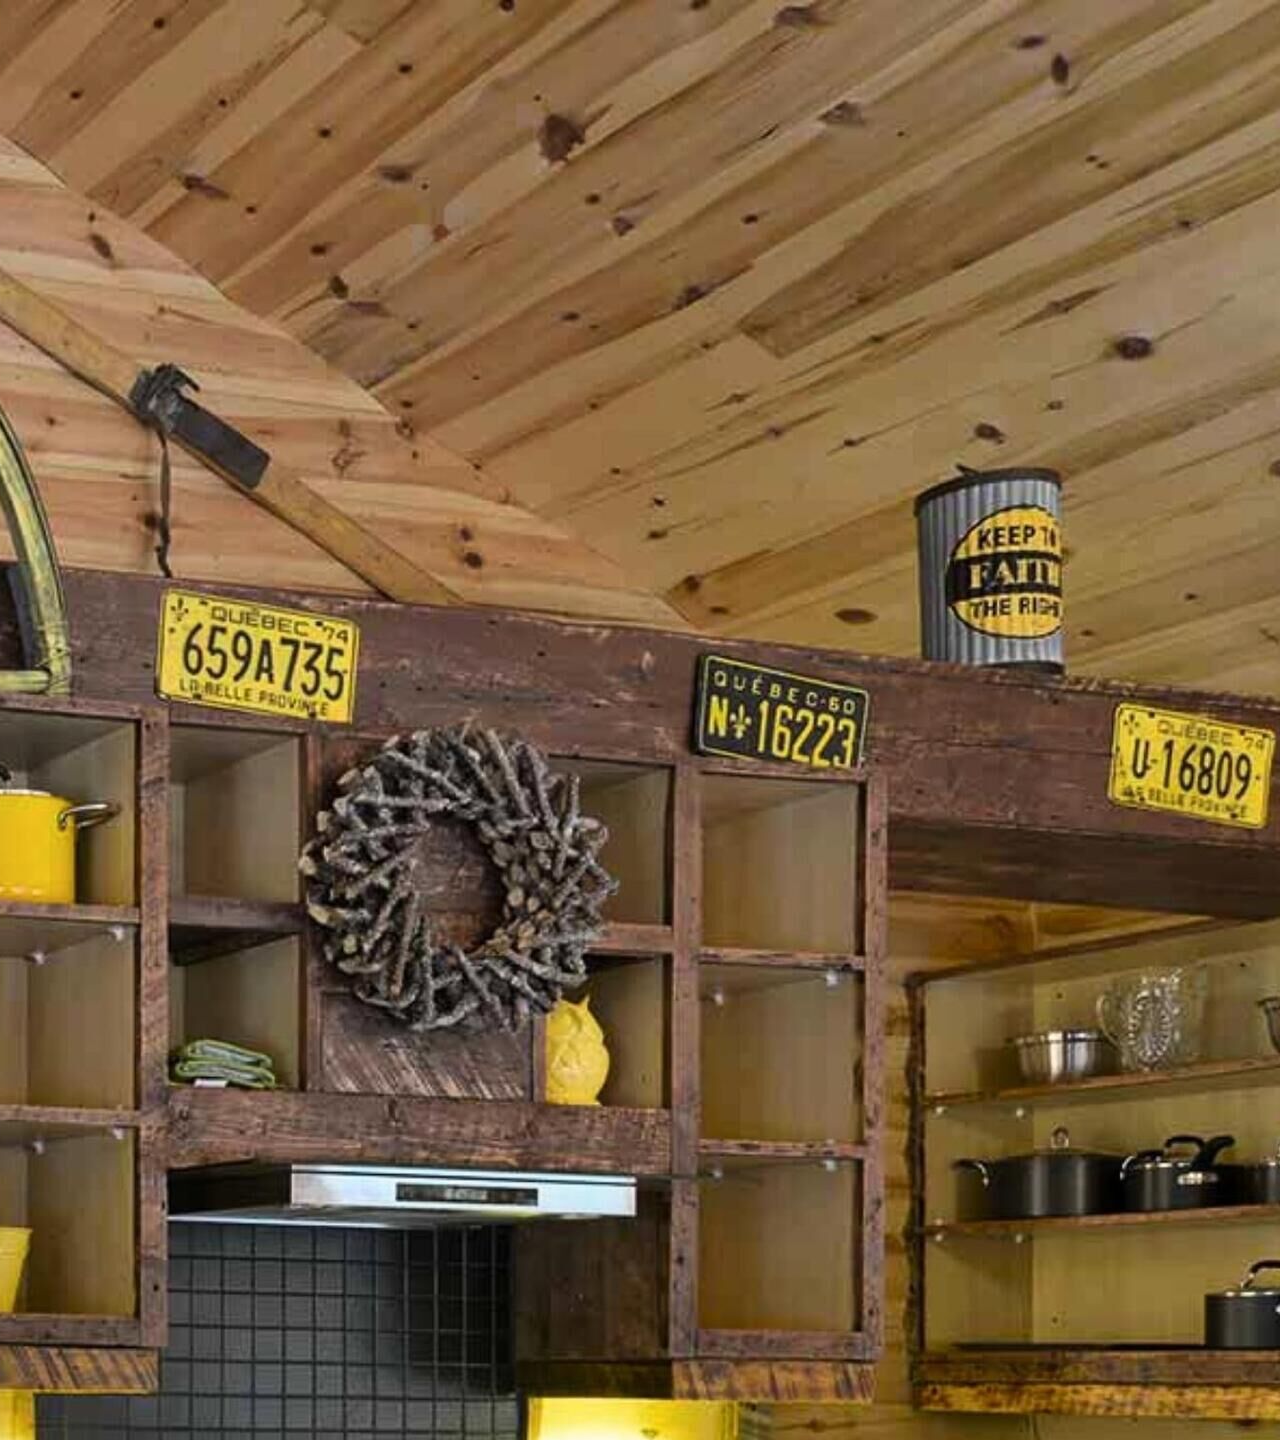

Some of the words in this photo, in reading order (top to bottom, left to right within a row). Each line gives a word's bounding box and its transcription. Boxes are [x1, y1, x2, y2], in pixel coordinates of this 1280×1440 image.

[977, 525, 1036, 550] KEEP
[970, 597, 1011, 618] THE
[183, 623, 345, 701] 659A735
